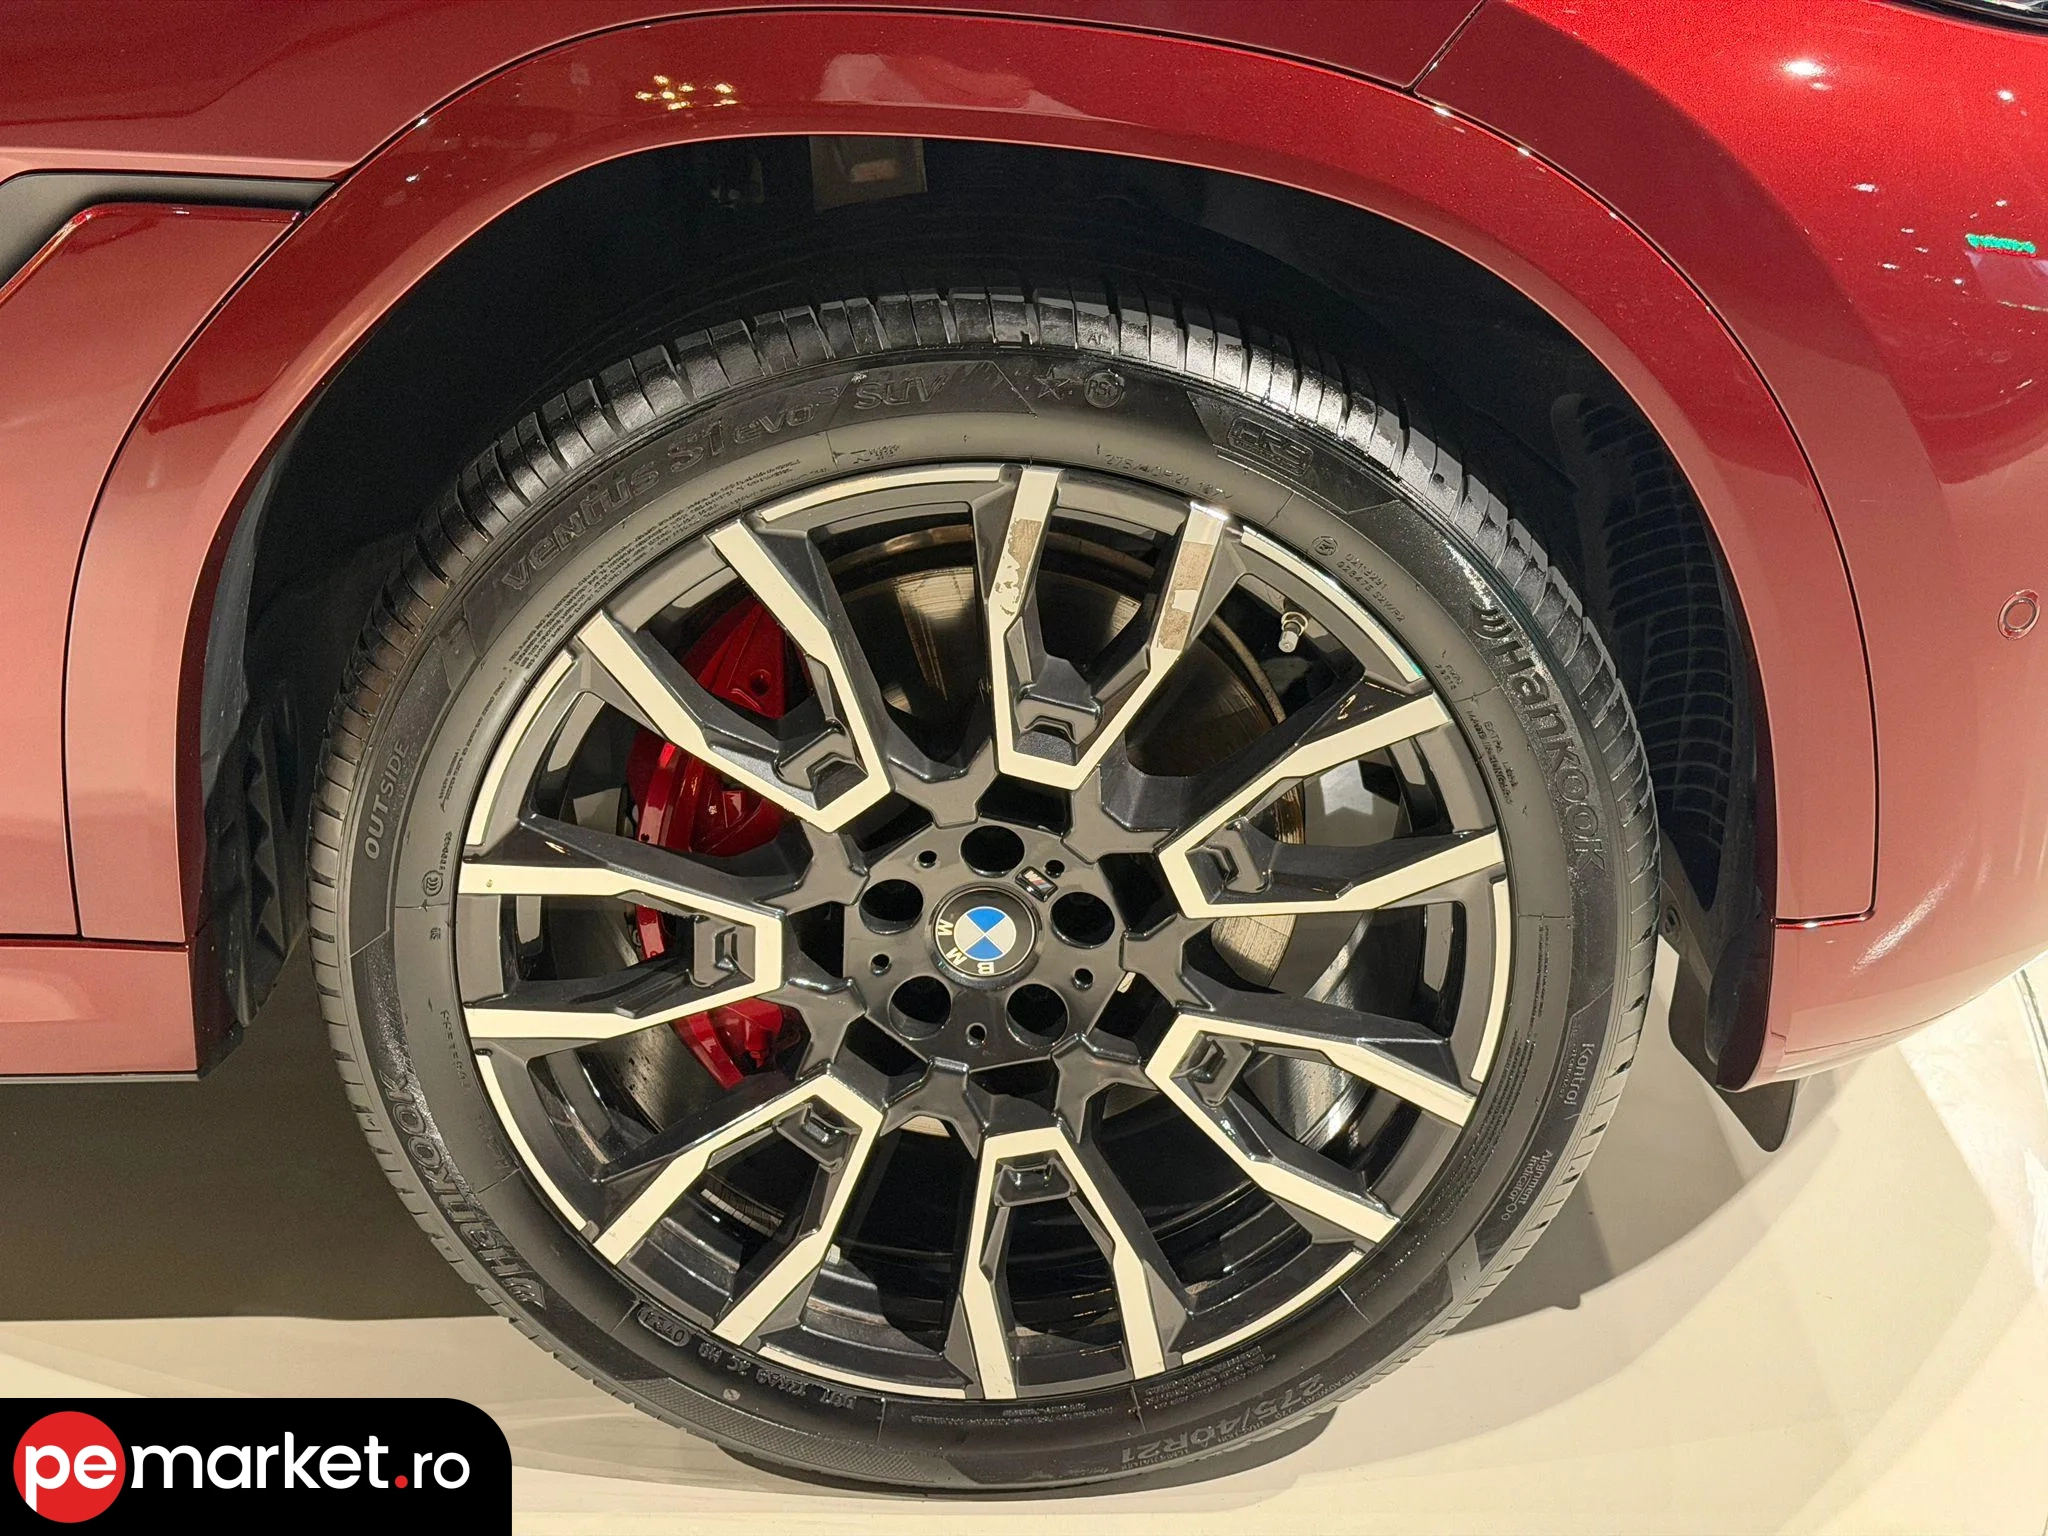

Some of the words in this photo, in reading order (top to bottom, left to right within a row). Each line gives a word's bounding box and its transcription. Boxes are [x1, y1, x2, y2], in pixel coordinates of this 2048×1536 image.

[852, 372, 947, 411] SUV
[1489, 636, 1611, 872] Hankook
[361, 737, 412, 859] OUTSIDE
[938, 919, 995, 975] BMW
[1562, 1041, 1594, 1107] Kontrol
[378, 1064, 521, 1283] Hankook
[1506, 1153, 1541, 1202] Indicator
[1515, 1148, 1554, 1206] Alignment
[1118, 1371, 1329, 1464] 275/40R21
